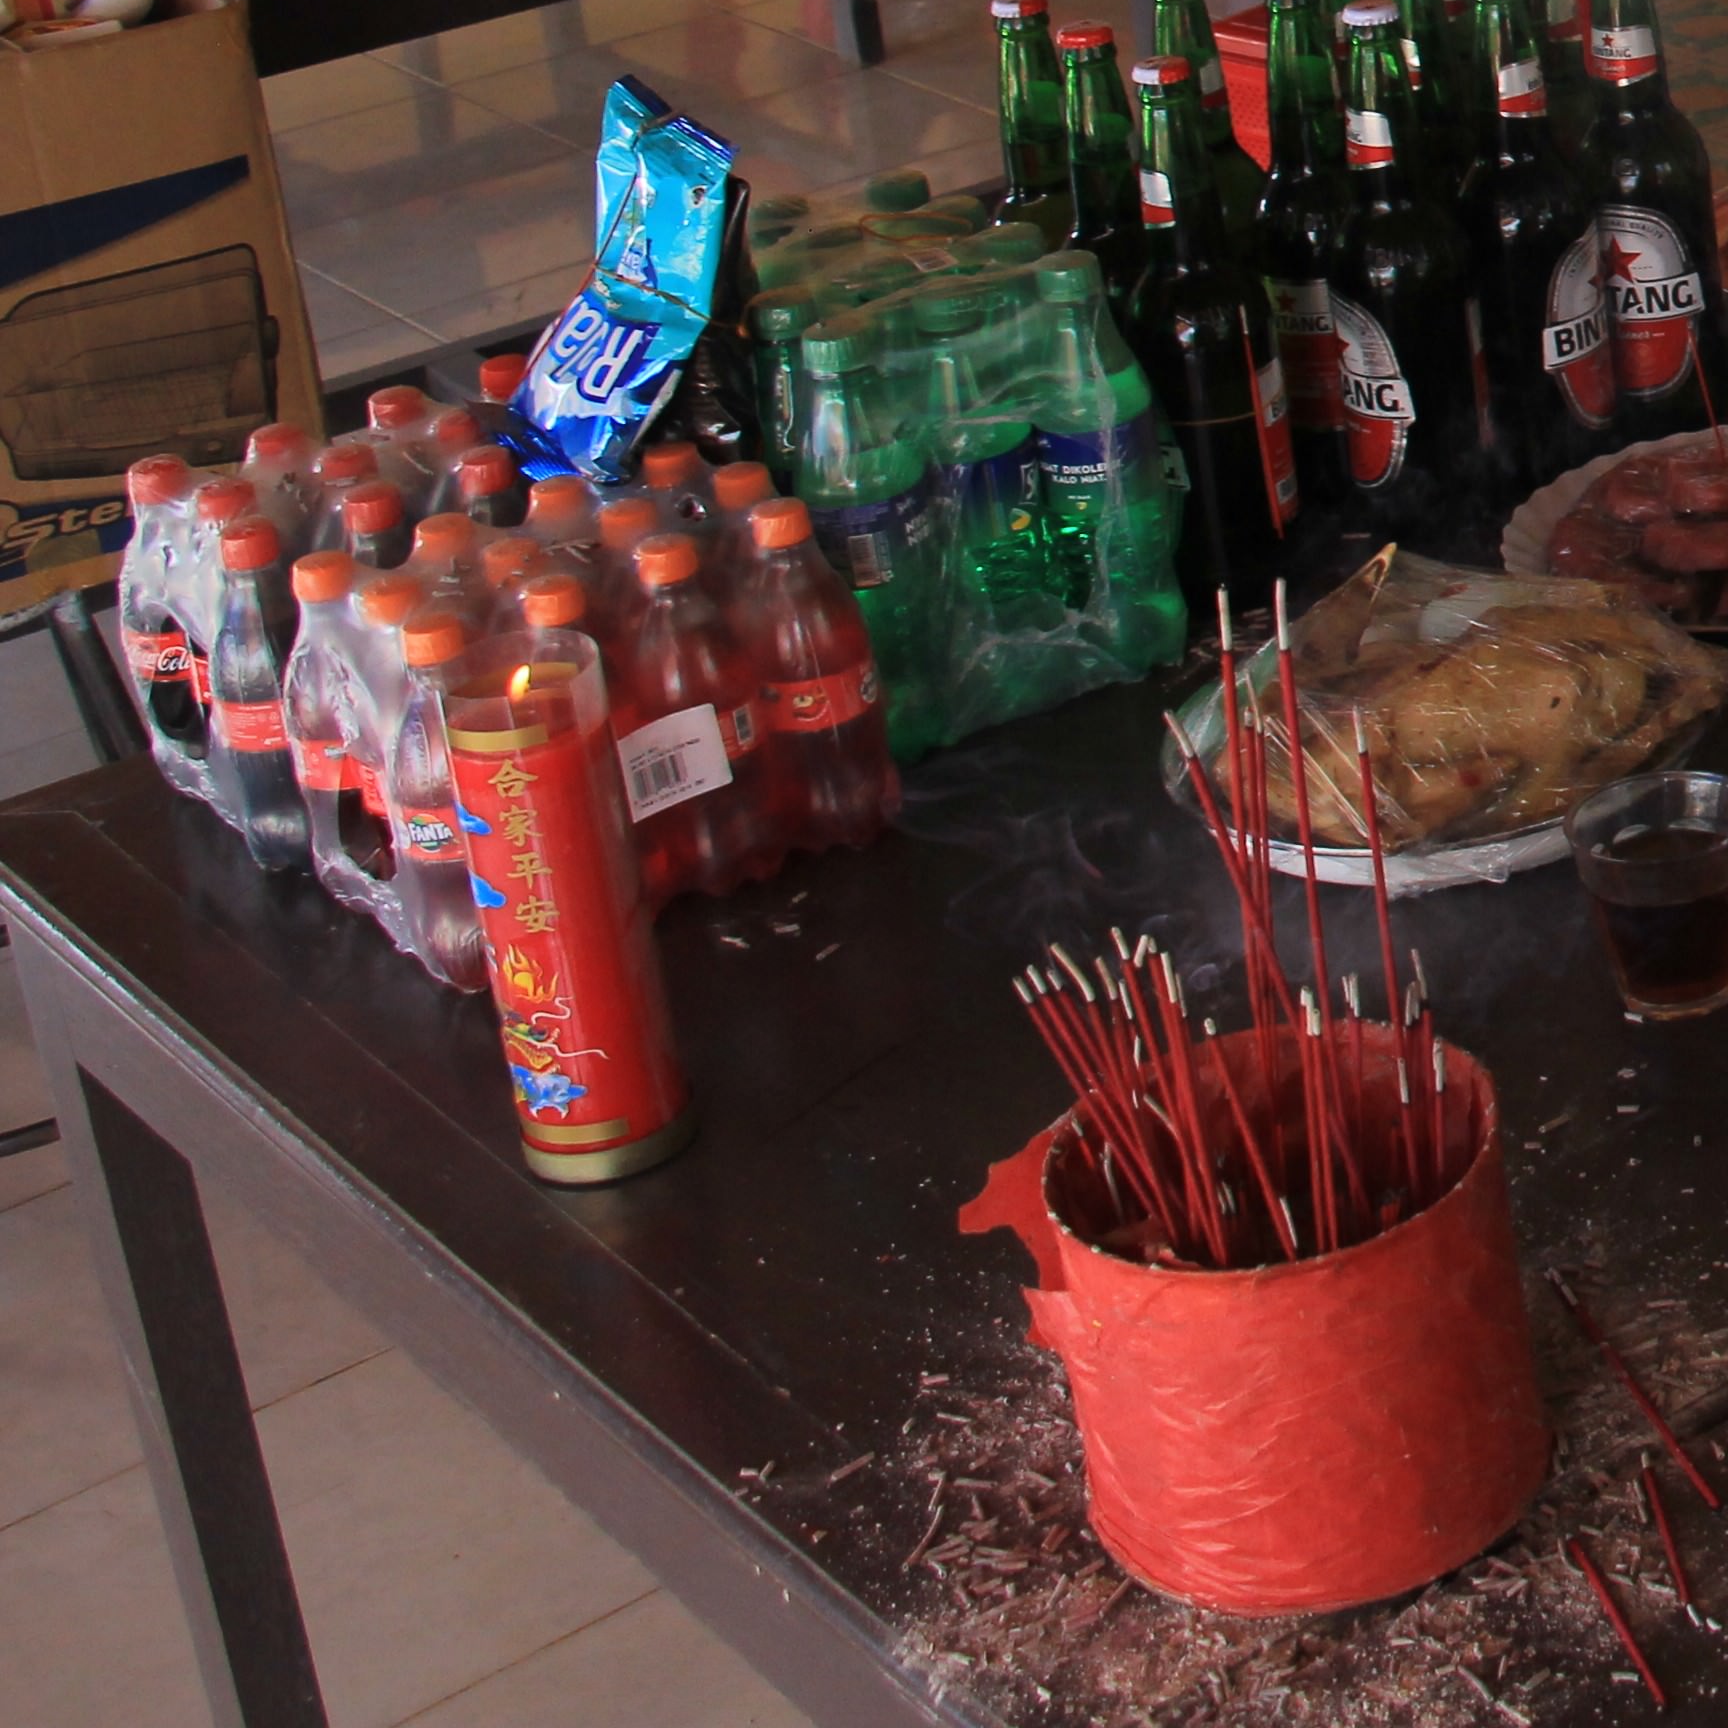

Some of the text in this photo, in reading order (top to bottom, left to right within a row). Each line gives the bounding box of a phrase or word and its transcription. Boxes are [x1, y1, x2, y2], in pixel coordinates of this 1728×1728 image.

[407, 822, 454, 843] FANTA
[487, 758, 561, 934] 合家平安
